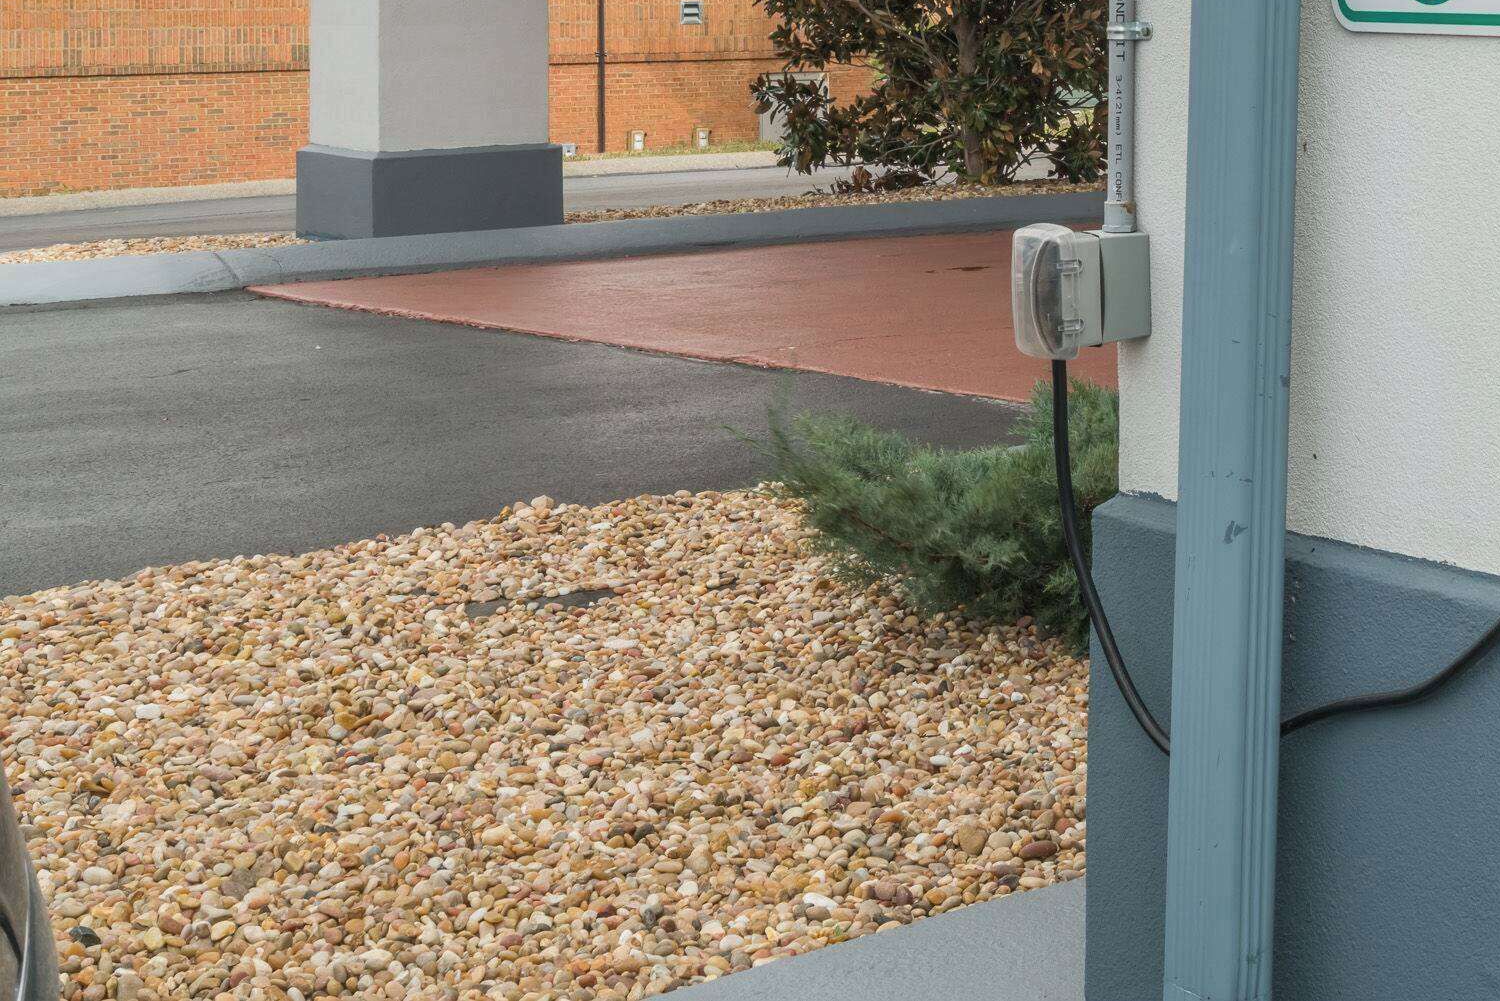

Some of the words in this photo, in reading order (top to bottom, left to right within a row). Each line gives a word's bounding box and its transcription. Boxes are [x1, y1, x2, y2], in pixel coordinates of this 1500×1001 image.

[1114, 75, 1123, 136] 3/4(21mm)
[1115, 144, 1123, 165] ETL
[1115, 171, 1123, 202] CONF
